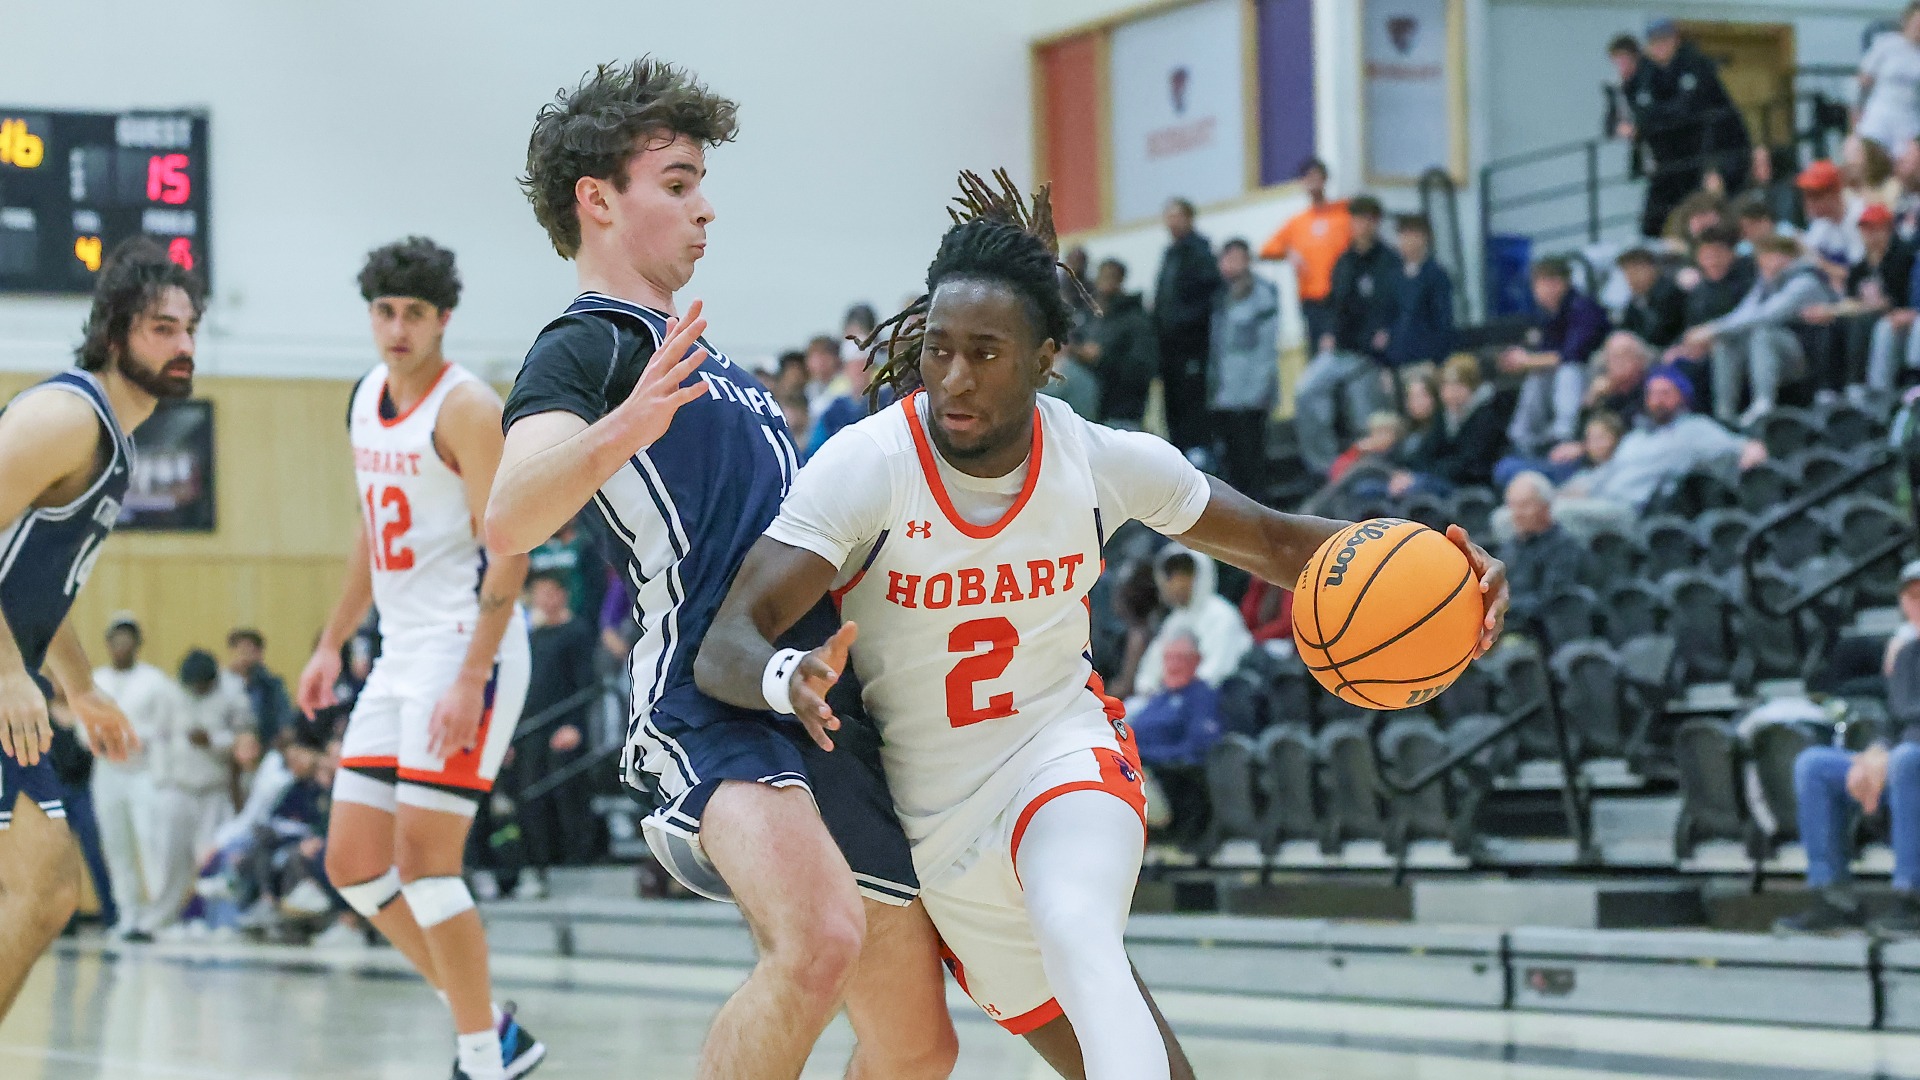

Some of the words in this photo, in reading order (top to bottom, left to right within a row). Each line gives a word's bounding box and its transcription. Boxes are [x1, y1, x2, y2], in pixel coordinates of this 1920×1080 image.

[146, 153, 191, 205] 15
[365, 484, 416, 571] 12
[885, 553, 1084, 610] HOBART
[945, 616, 1020, 729] 2
